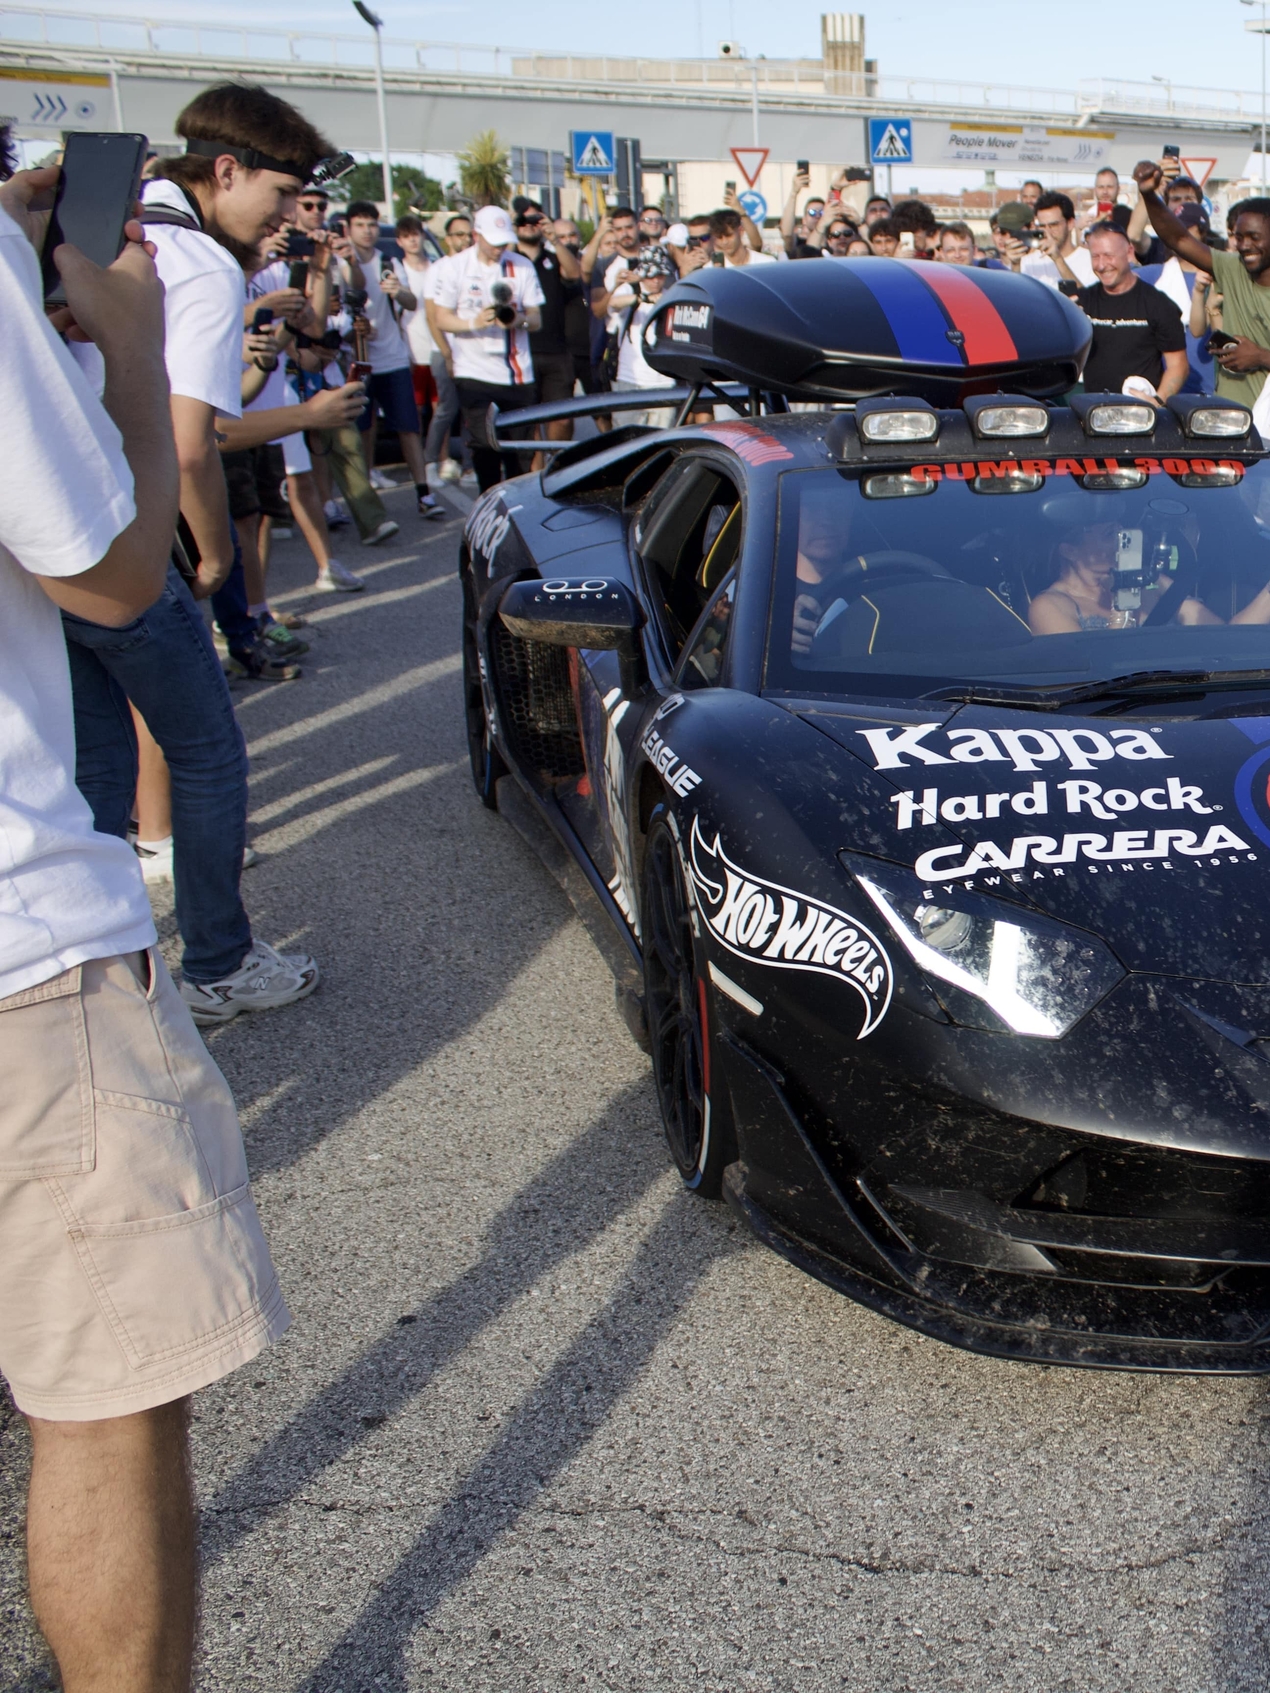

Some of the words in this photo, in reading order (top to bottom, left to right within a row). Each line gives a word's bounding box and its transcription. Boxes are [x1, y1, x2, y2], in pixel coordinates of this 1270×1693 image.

[949, 133, 985, 148] People
[986, 135, 1018, 149] Mover
[910, 458, 1119, 482] GUMBALL
[1133, 457, 1246, 475] 3000
[535, 593, 618, 602] LONDON
[641, 730, 703, 798] LEAGUE
[855, 723, 1175, 771] Kappa
[890, 781, 1049, 830] Hard
[1057, 777, 1214, 820] Rock
[915, 824, 1251, 882] CARRERA
[1088, 861, 1174, 874] SINCE
[1194, 853, 1258, 868] 1956
